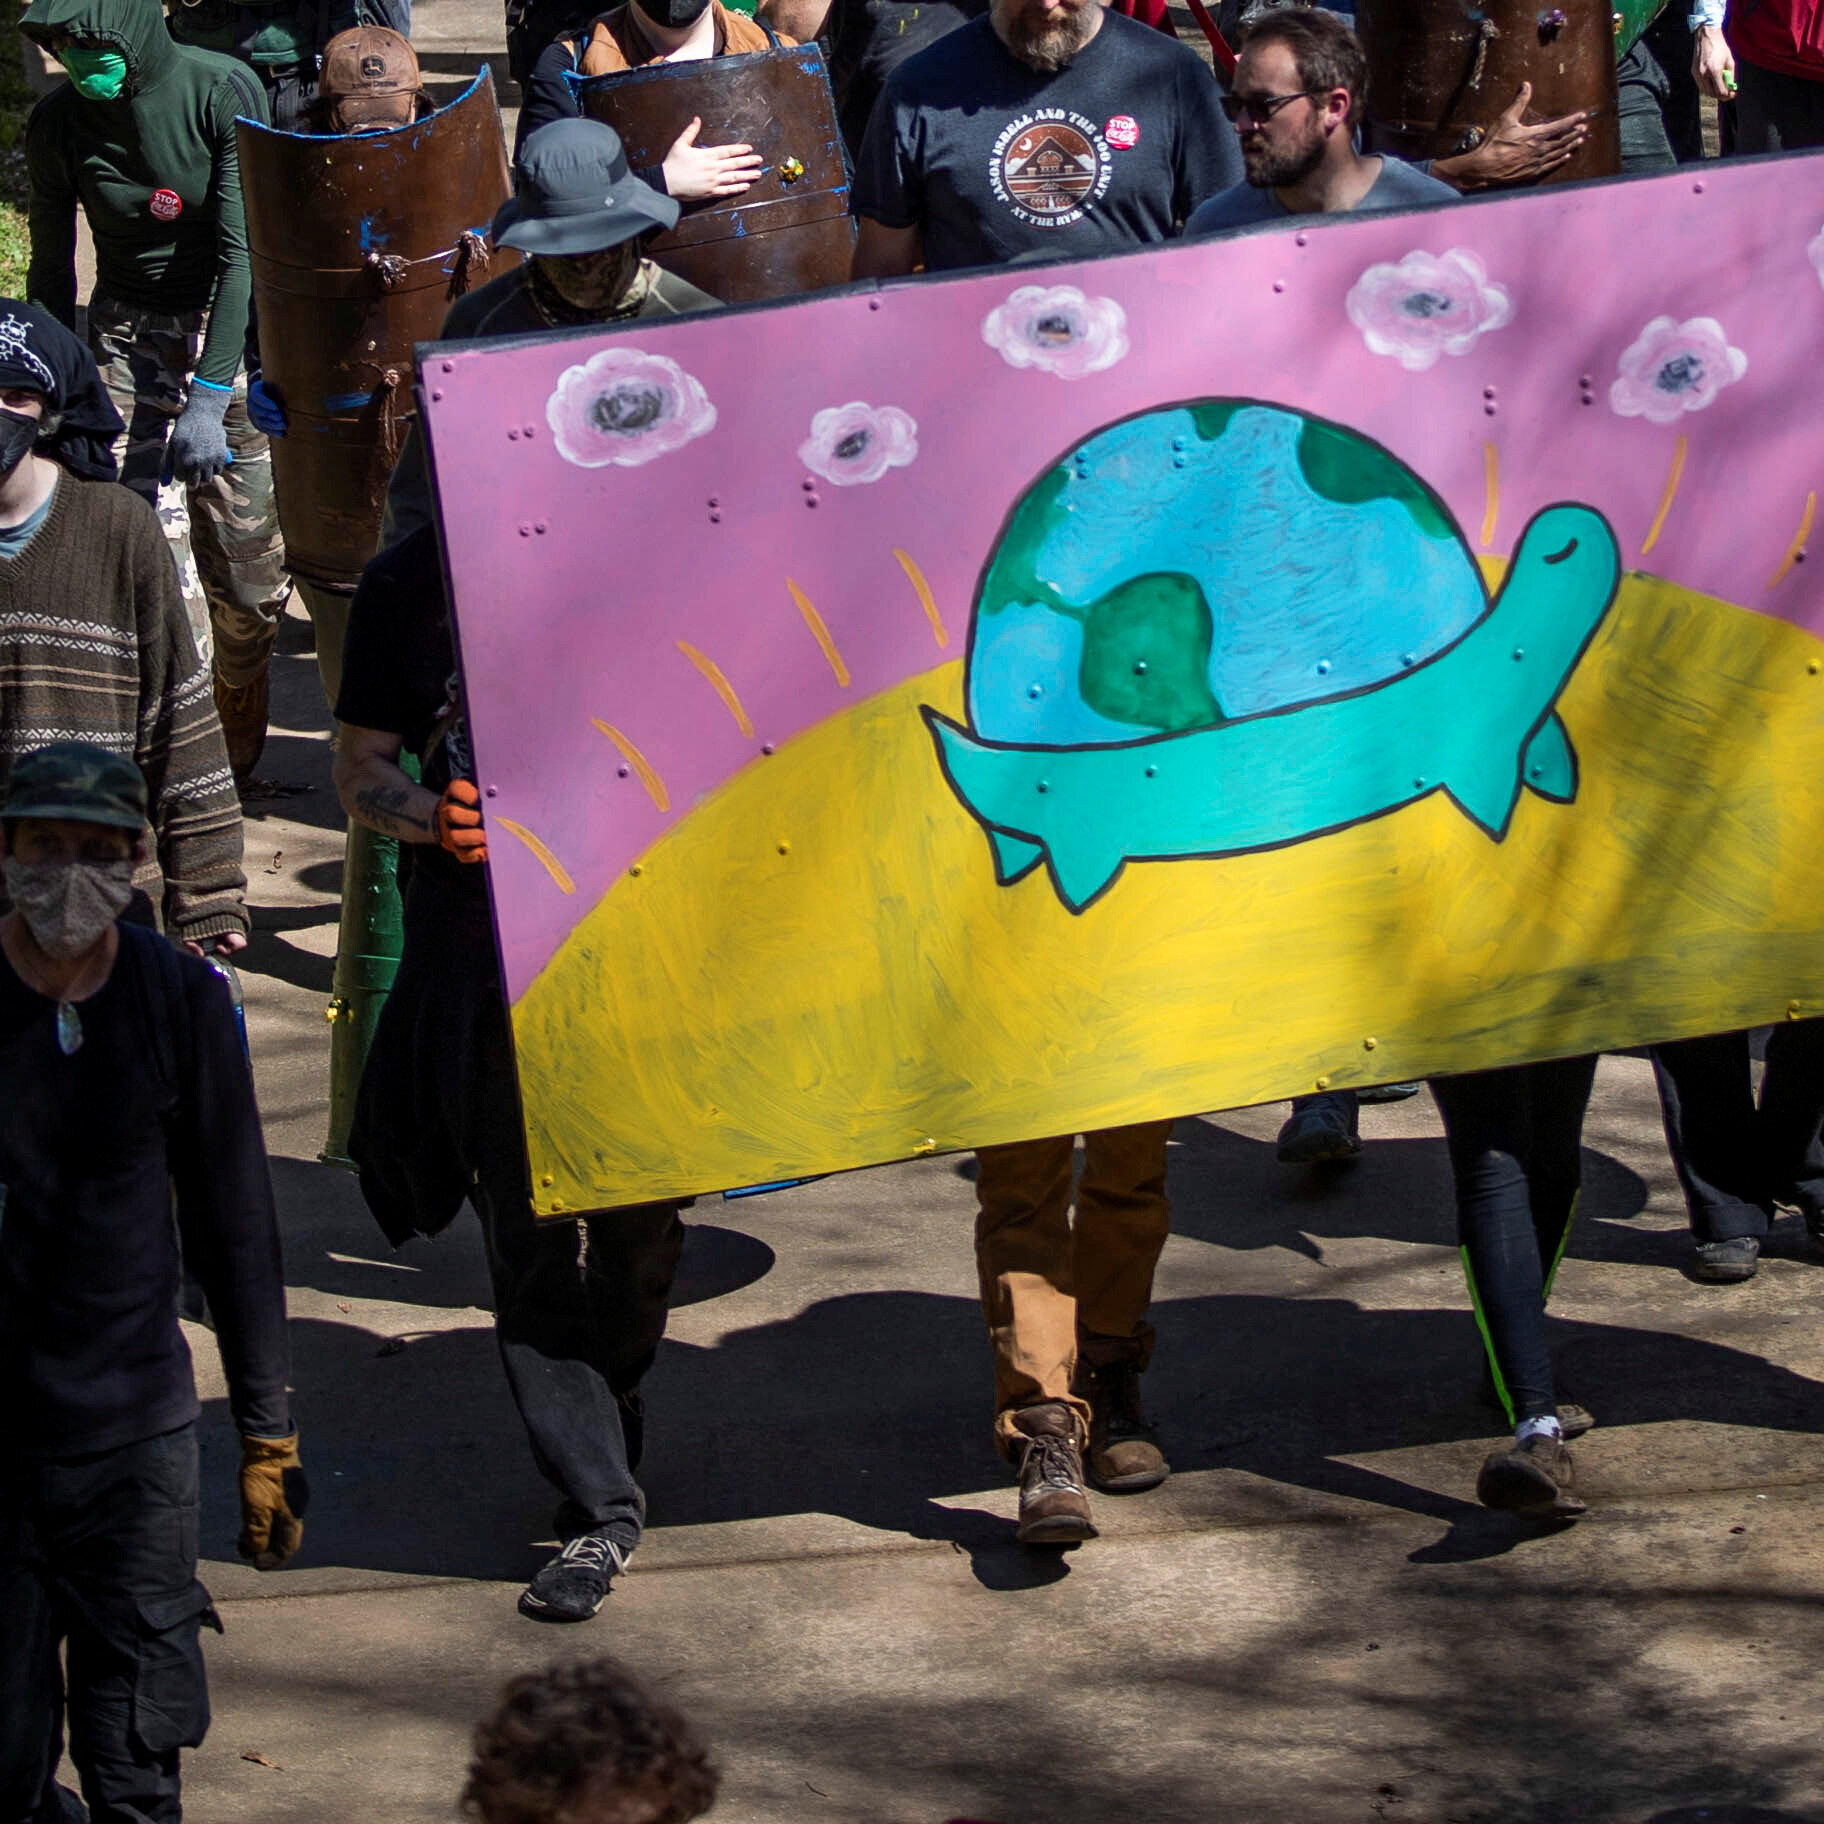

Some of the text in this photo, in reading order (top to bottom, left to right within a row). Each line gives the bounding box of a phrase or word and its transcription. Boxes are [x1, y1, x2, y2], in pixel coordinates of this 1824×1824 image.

[1034, 108, 1067, 121] AND
[1068, 111, 1098, 136] THE
[992, 113, 1034, 157] ISBELL
[988, 157, 1010, 203] JASON
[1093, 164, 1113, 200] UNIT
[154, 192, 178, 205] STOP
[1010, 206, 1029, 220] AT
[1028, 214, 1055, 227] THE
